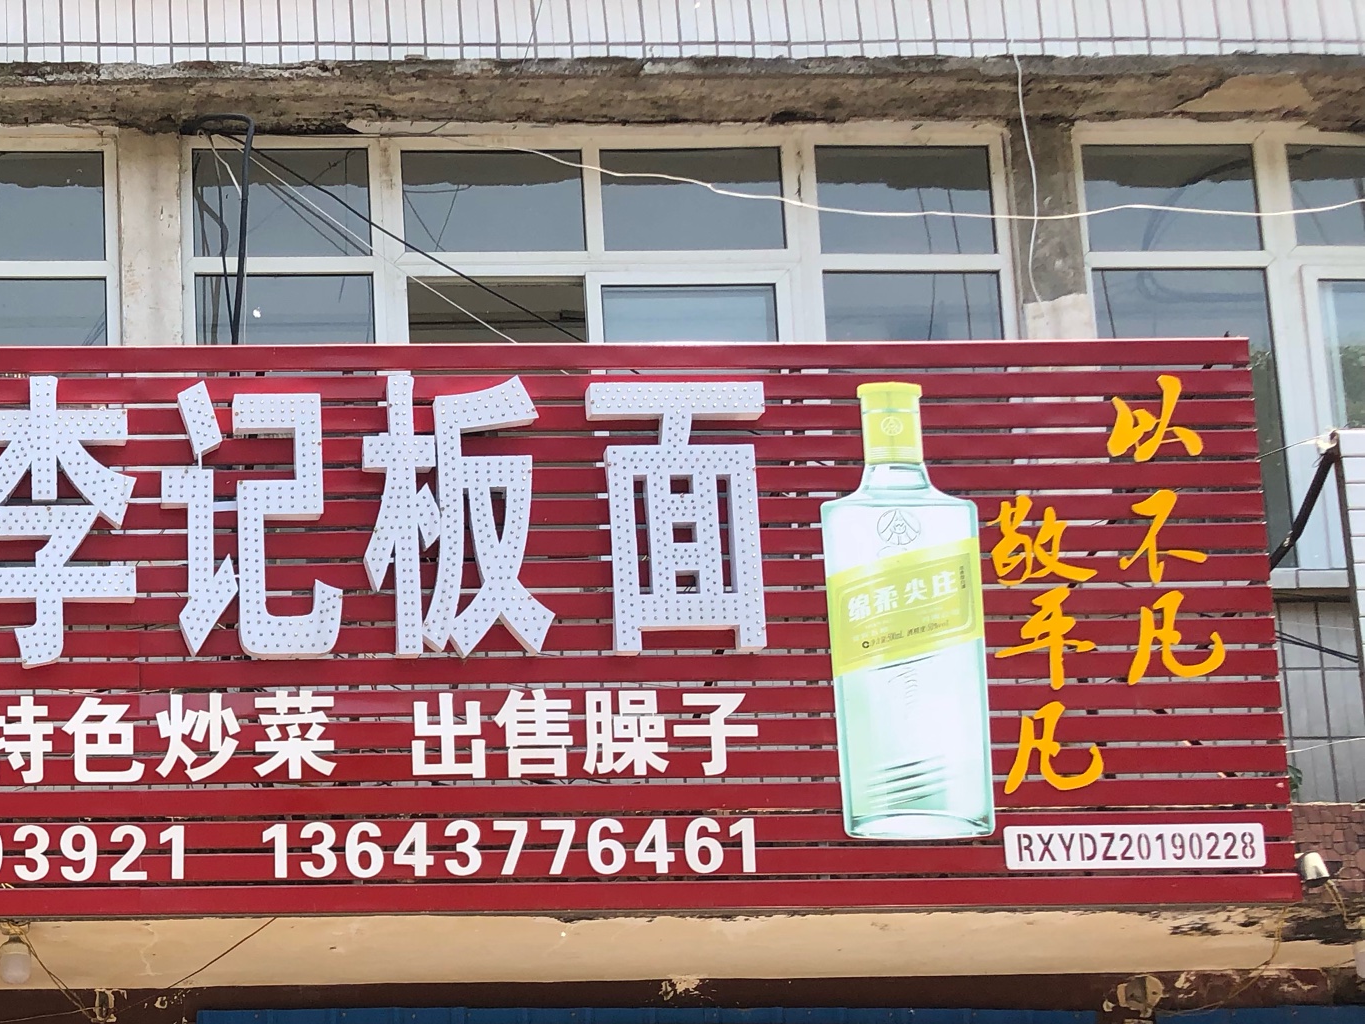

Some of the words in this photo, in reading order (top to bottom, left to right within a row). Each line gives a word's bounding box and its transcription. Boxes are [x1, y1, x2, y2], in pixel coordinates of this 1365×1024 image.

[848, 570, 958, 622] 绵柔尖庄
[411, 689, 759, 779] 出售臊子
[262, 816, 759, 880] 13643776461
[1017, 832, 1257, 862] RXYDZ20190228
